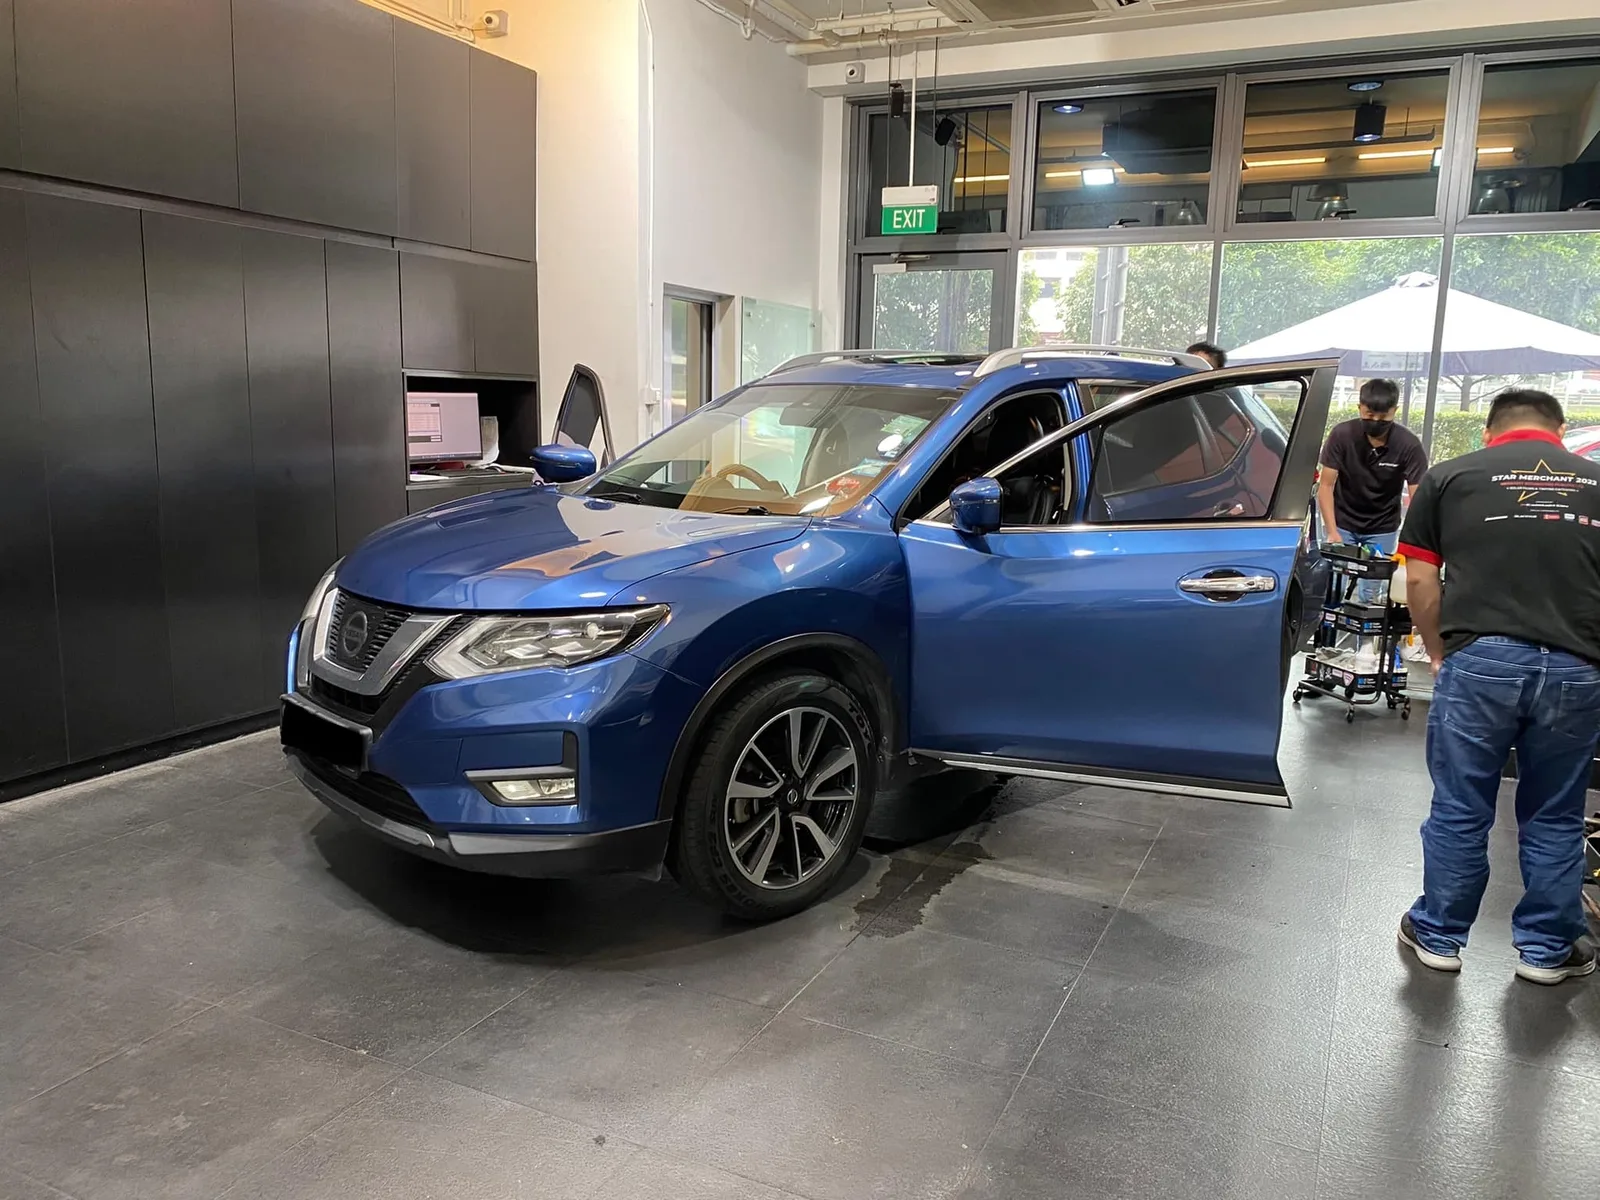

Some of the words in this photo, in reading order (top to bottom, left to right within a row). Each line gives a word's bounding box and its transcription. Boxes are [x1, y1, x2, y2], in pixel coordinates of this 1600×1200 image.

[893, 209, 926, 229] EXIT
[1491, 474, 1516, 482] STAR
[1518, 475, 1574, 483] MERCHANT
